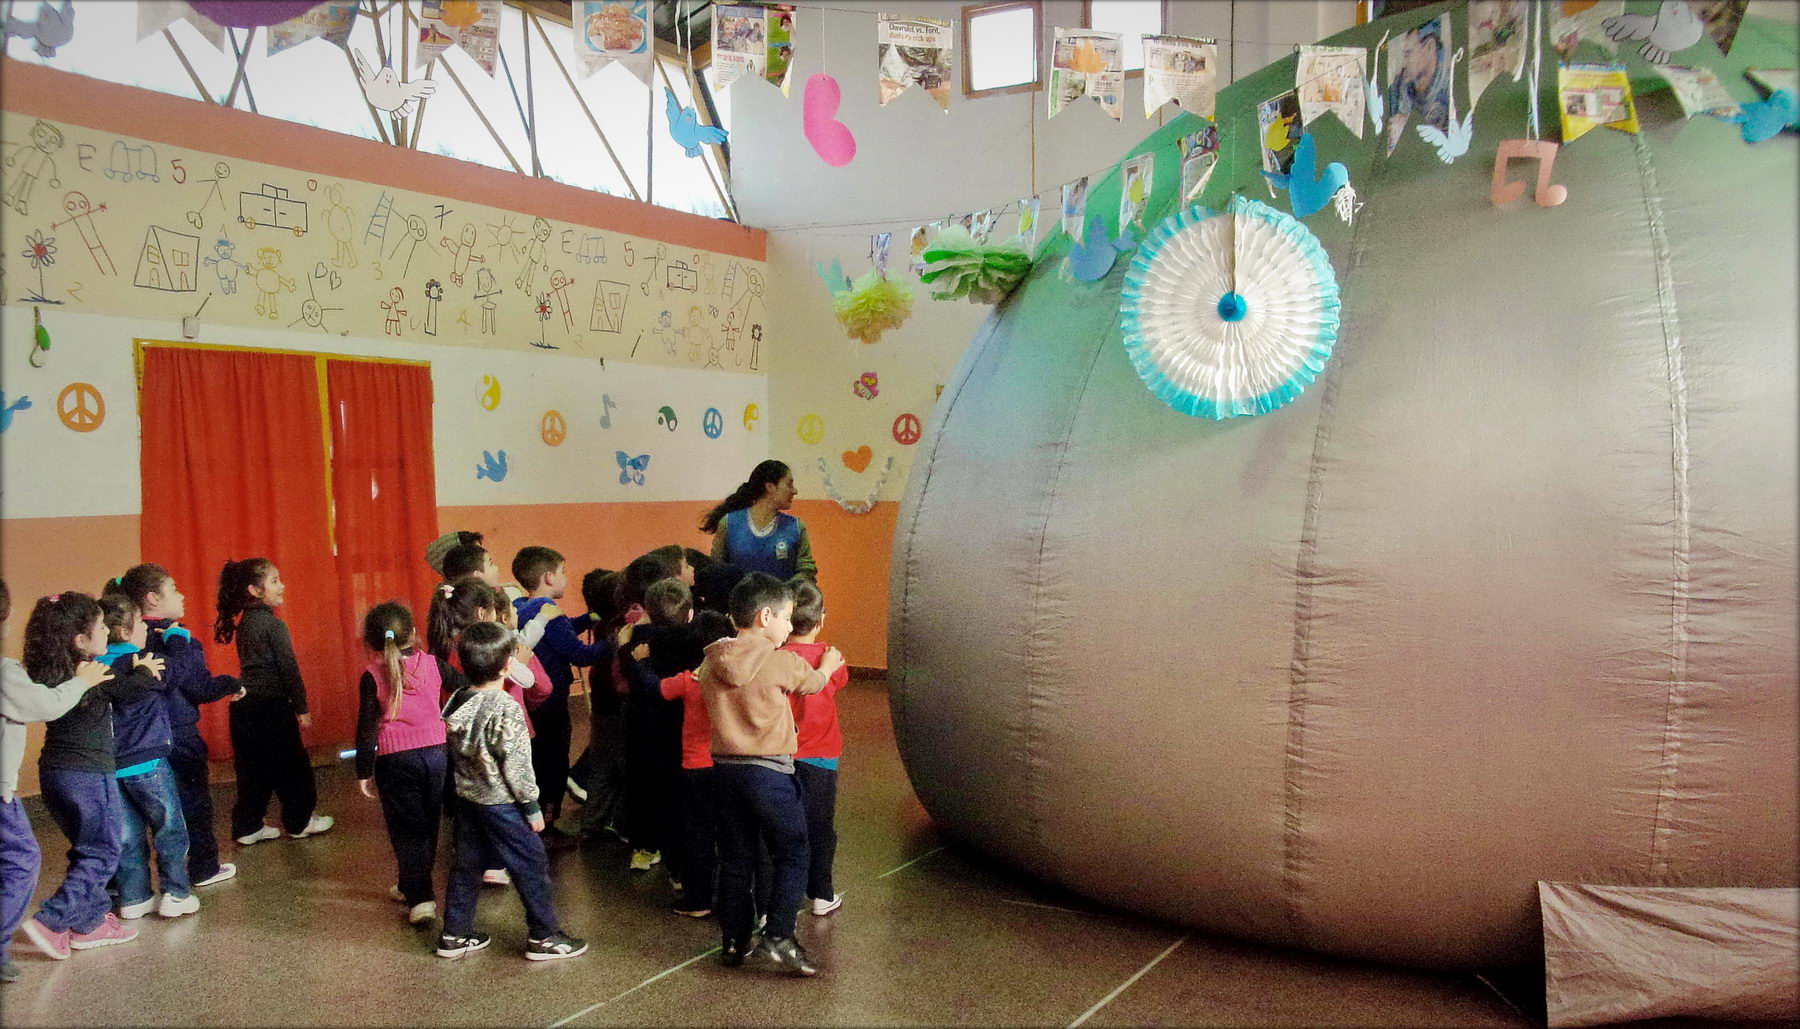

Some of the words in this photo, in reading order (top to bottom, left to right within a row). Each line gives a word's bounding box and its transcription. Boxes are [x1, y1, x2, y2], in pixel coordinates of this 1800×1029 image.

[77, 143, 97, 172] E
[170, 158, 187, 184] 5
[434, 204, 454, 230] 7
[561, 230, 574, 254] E
[624, 241, 635, 267] 5
[371, 261, 383, 280] 3
[67, 280, 83, 303] 2
